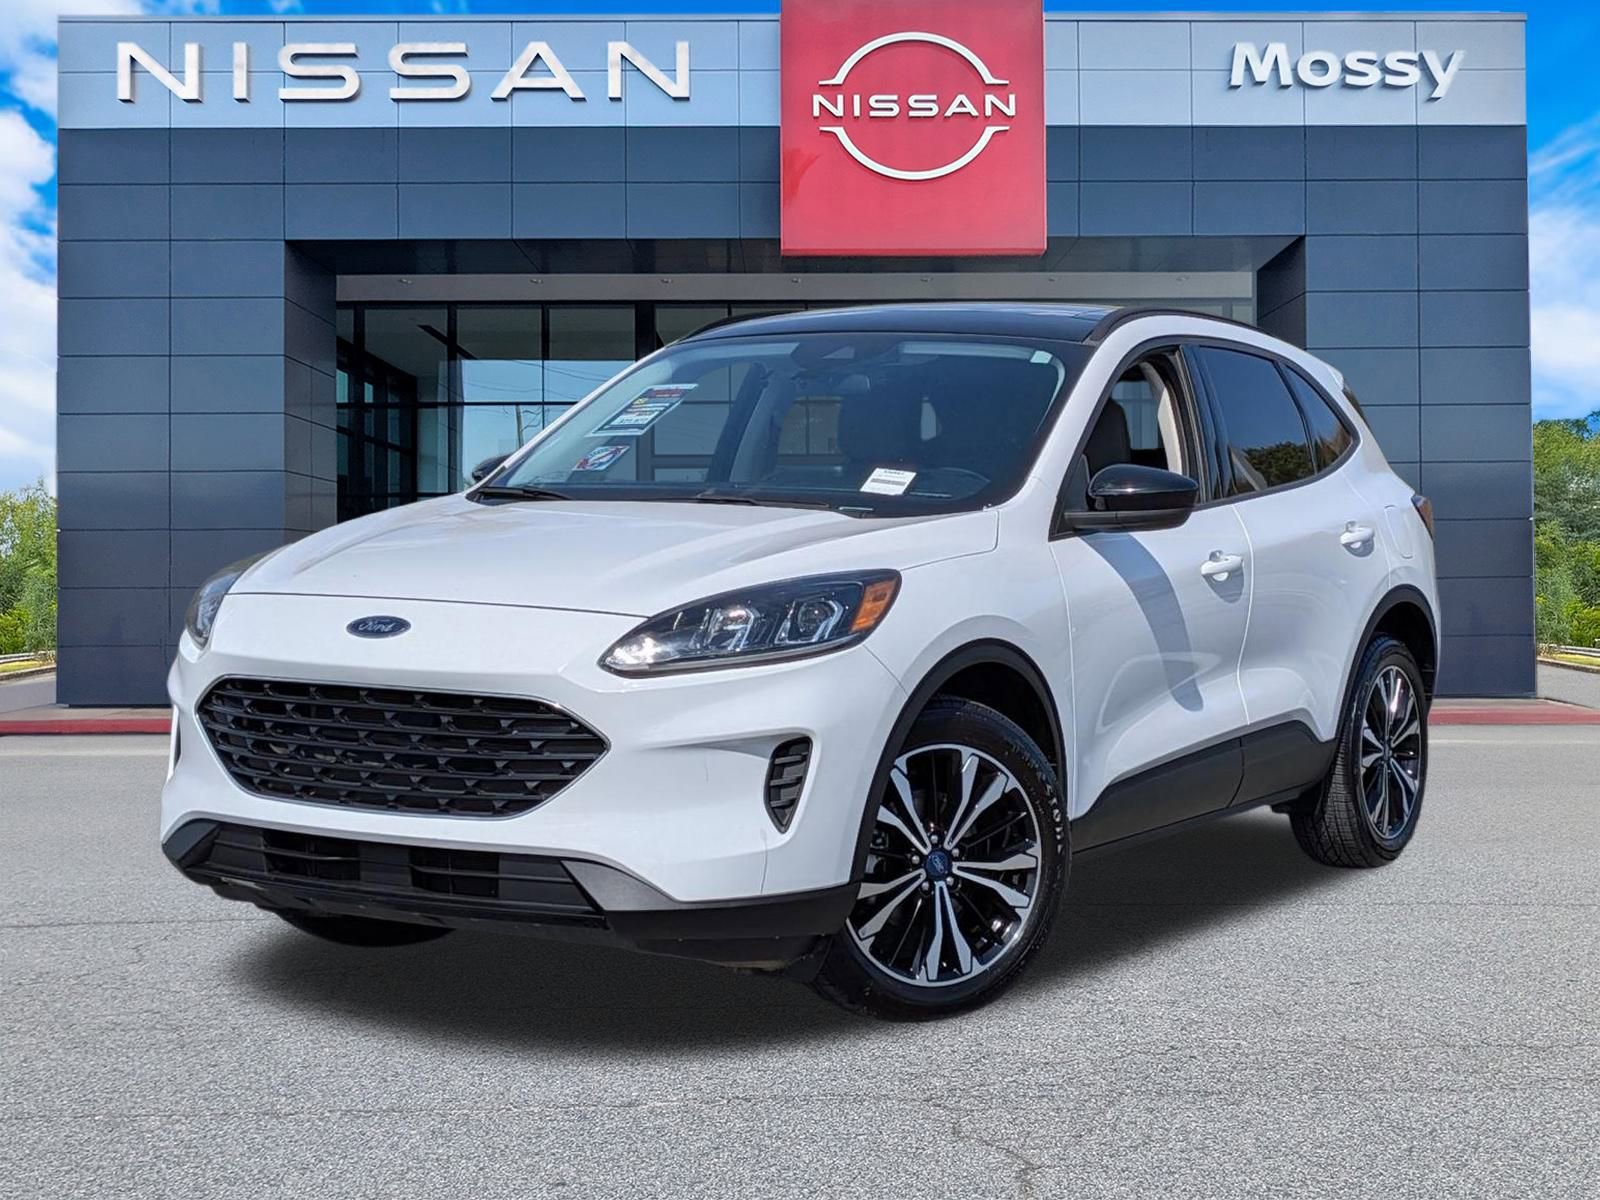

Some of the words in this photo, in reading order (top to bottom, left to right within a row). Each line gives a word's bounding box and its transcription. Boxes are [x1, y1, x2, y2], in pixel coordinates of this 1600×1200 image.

[117, 41, 691, 102] NISSAN
[1229, 42, 1465, 101] Mossy
[812, 93, 1017, 118] NISSAN
[357, 618, 396, 633] Ford
